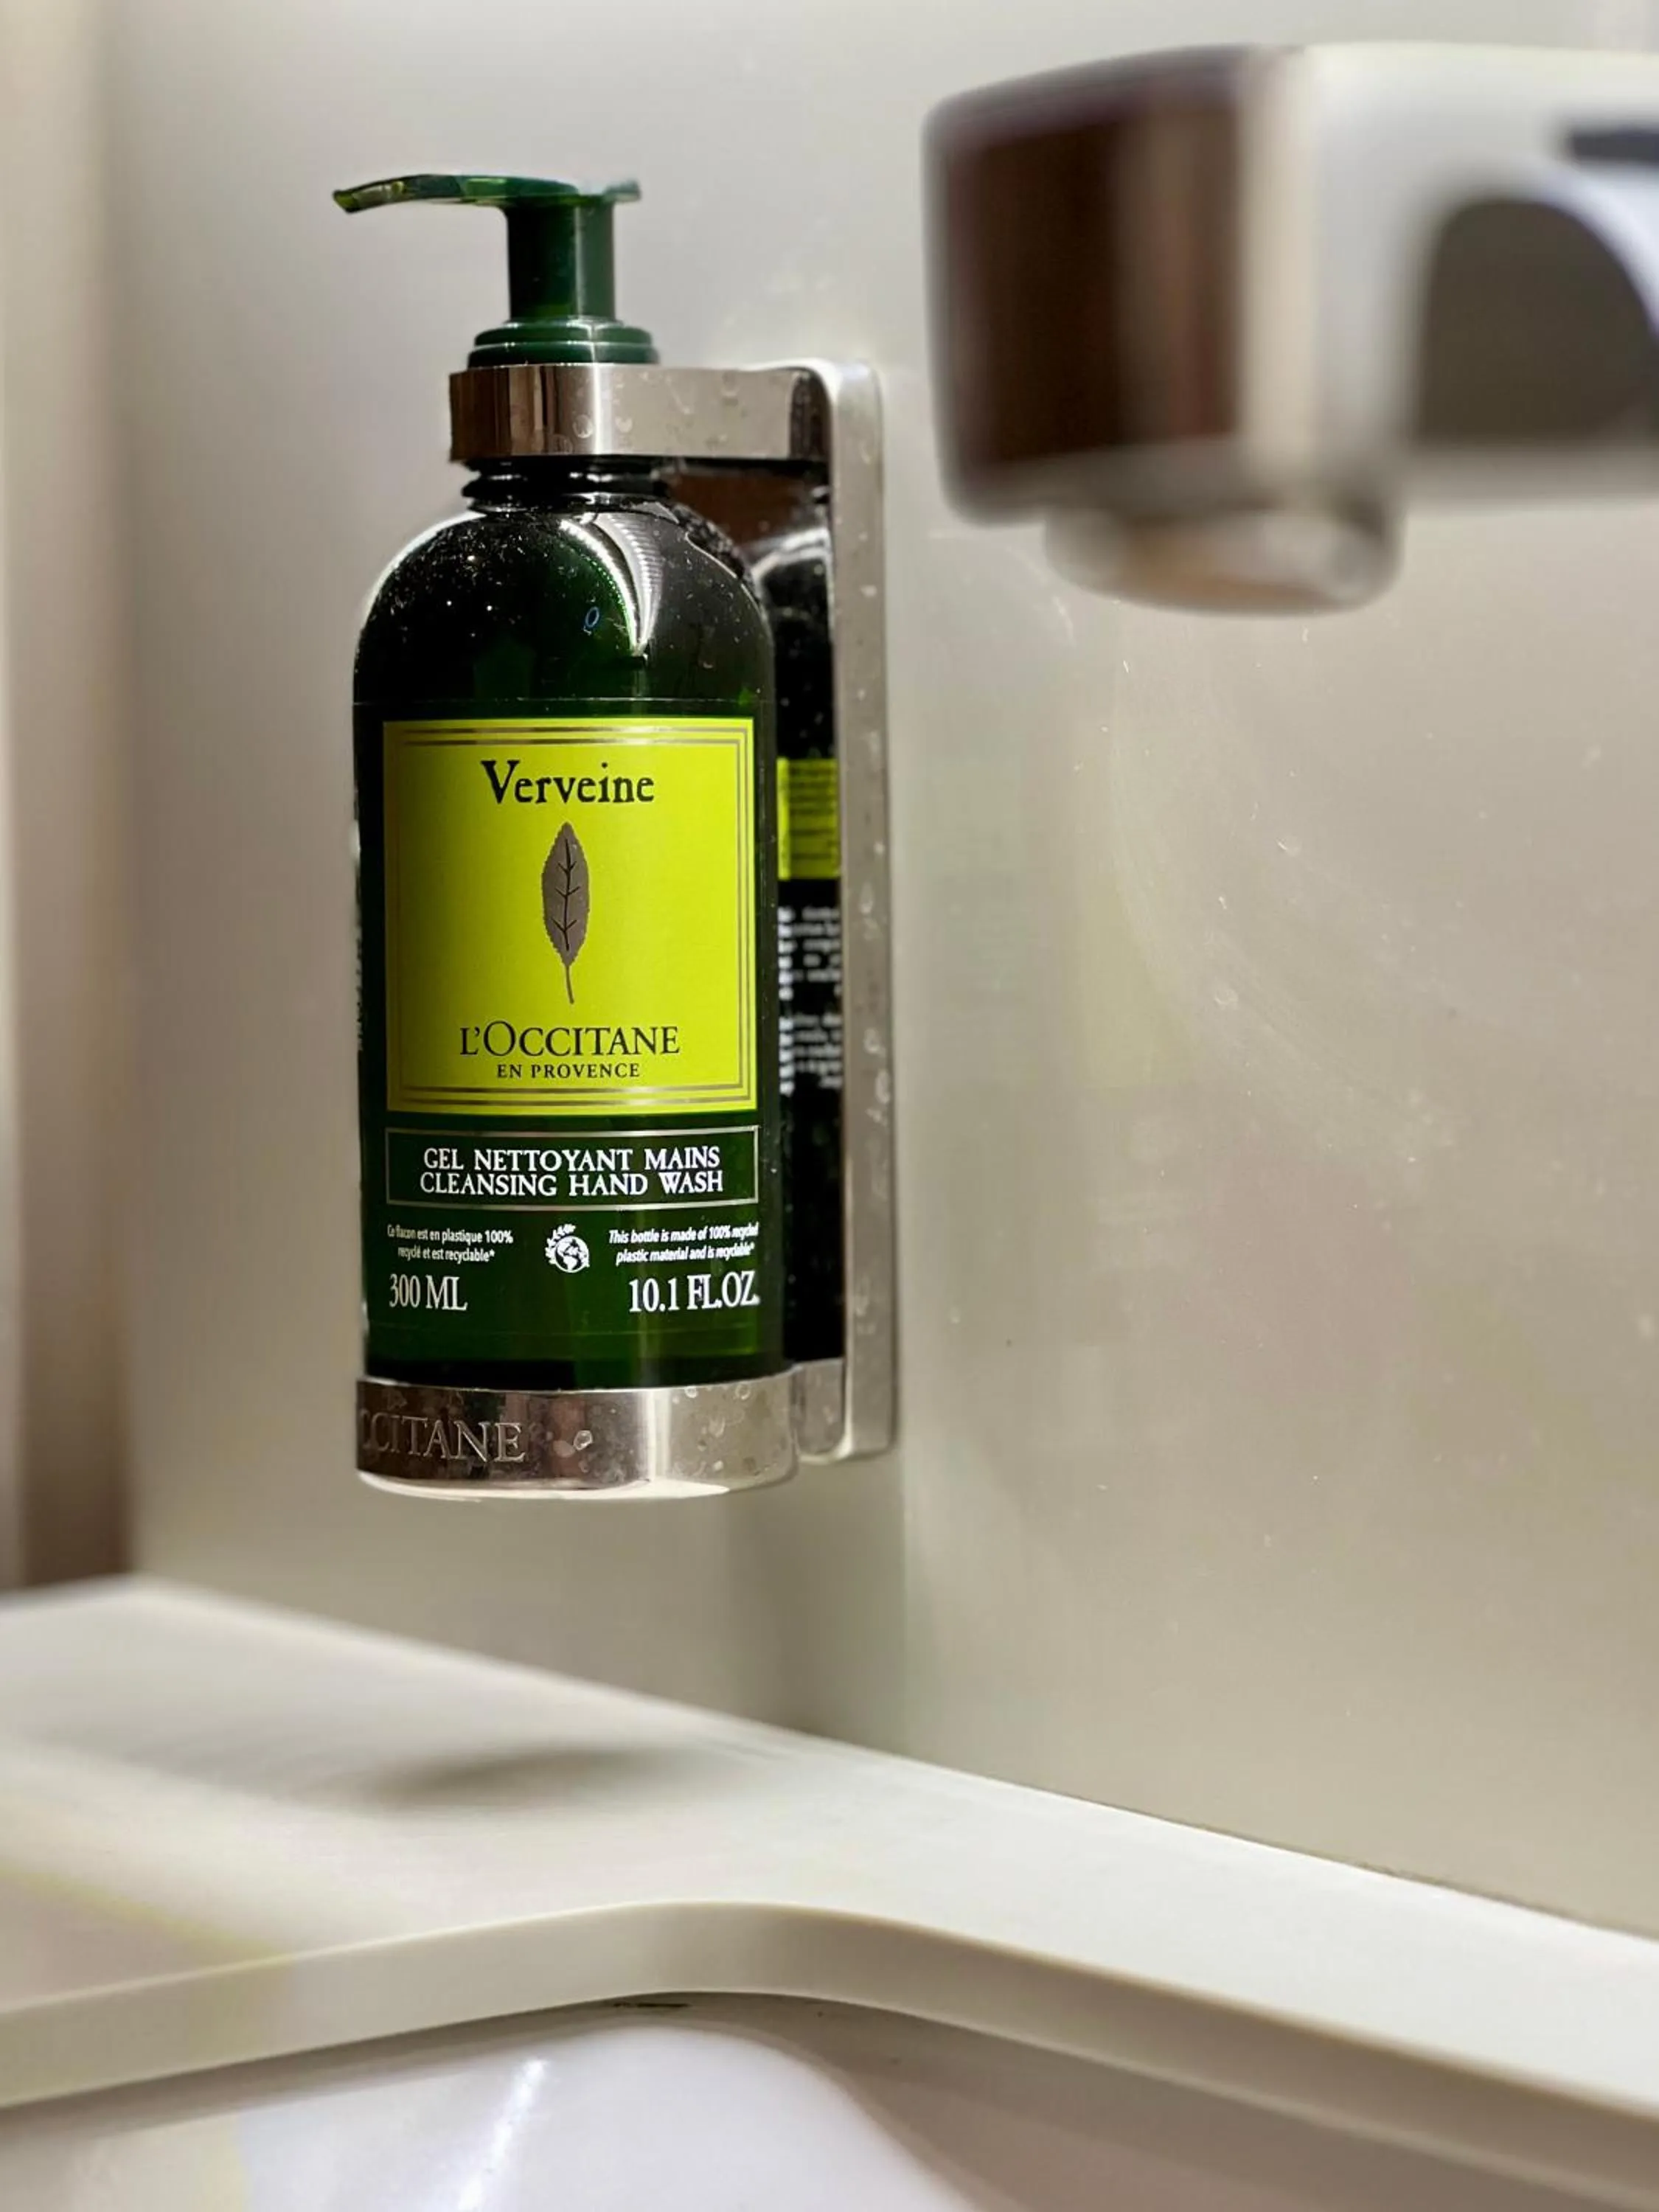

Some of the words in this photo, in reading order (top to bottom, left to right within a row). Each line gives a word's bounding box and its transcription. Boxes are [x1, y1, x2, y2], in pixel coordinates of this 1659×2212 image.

[481, 759, 655, 804] Verveine
[497, 1064, 522, 1078] EN
[531, 1062, 640, 1079] PROVENCE
[424, 1148, 464, 1170] GEL
[474, 1149, 633, 1172] NETTOYANT
[644, 1146, 721, 1170] MAINS
[420, 1172, 557, 1197] CLEANSING
[569, 1174, 648, 1196] HAND
[659, 1170, 723, 1194] WASH
[417, 1229, 428, 1240] est
[430, 1230, 440, 1241] en
[442, 1228, 483, 1245] plastique
[484, 1230, 514, 1244] 100%
[609, 1229, 629, 1243] This
[630, 1228, 659, 1243] bottle
[661, 1228, 669, 1242] is
[670, 1226, 696, 1241] made
[698, 1225, 709, 1239] of
[709, 1224, 731, 1239] 100%
[422, 1248, 431, 1259] et
[432, 1249, 445, 1260] est
[616, 1248, 649, 1266] plastic
[650, 1246, 688, 1262] material
[690, 1245, 707, 1260] and
[708, 1246, 715, 1259] is
[389, 1274, 420, 1308] 300
[425, 1275, 468, 1311] ML
[629, 1277, 681, 1312] 10.1
